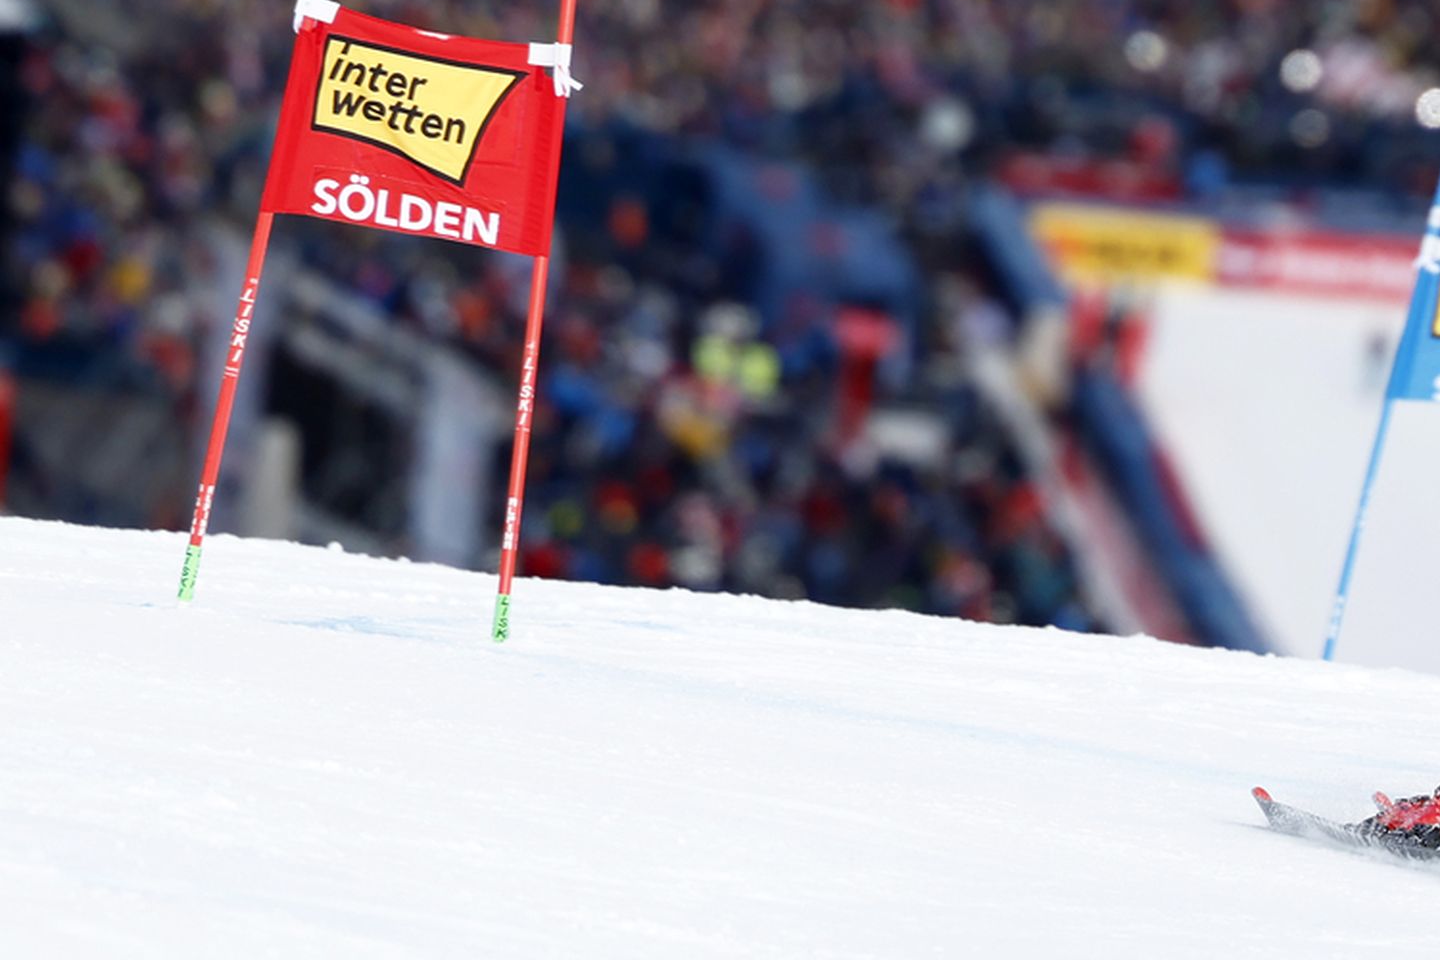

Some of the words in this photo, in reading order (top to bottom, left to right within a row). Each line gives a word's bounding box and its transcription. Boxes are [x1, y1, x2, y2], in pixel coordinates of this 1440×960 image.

[328, 42, 428, 101] inter
[331, 90, 466, 145] wetten
[311, 173, 500, 245] SÖLDEN
